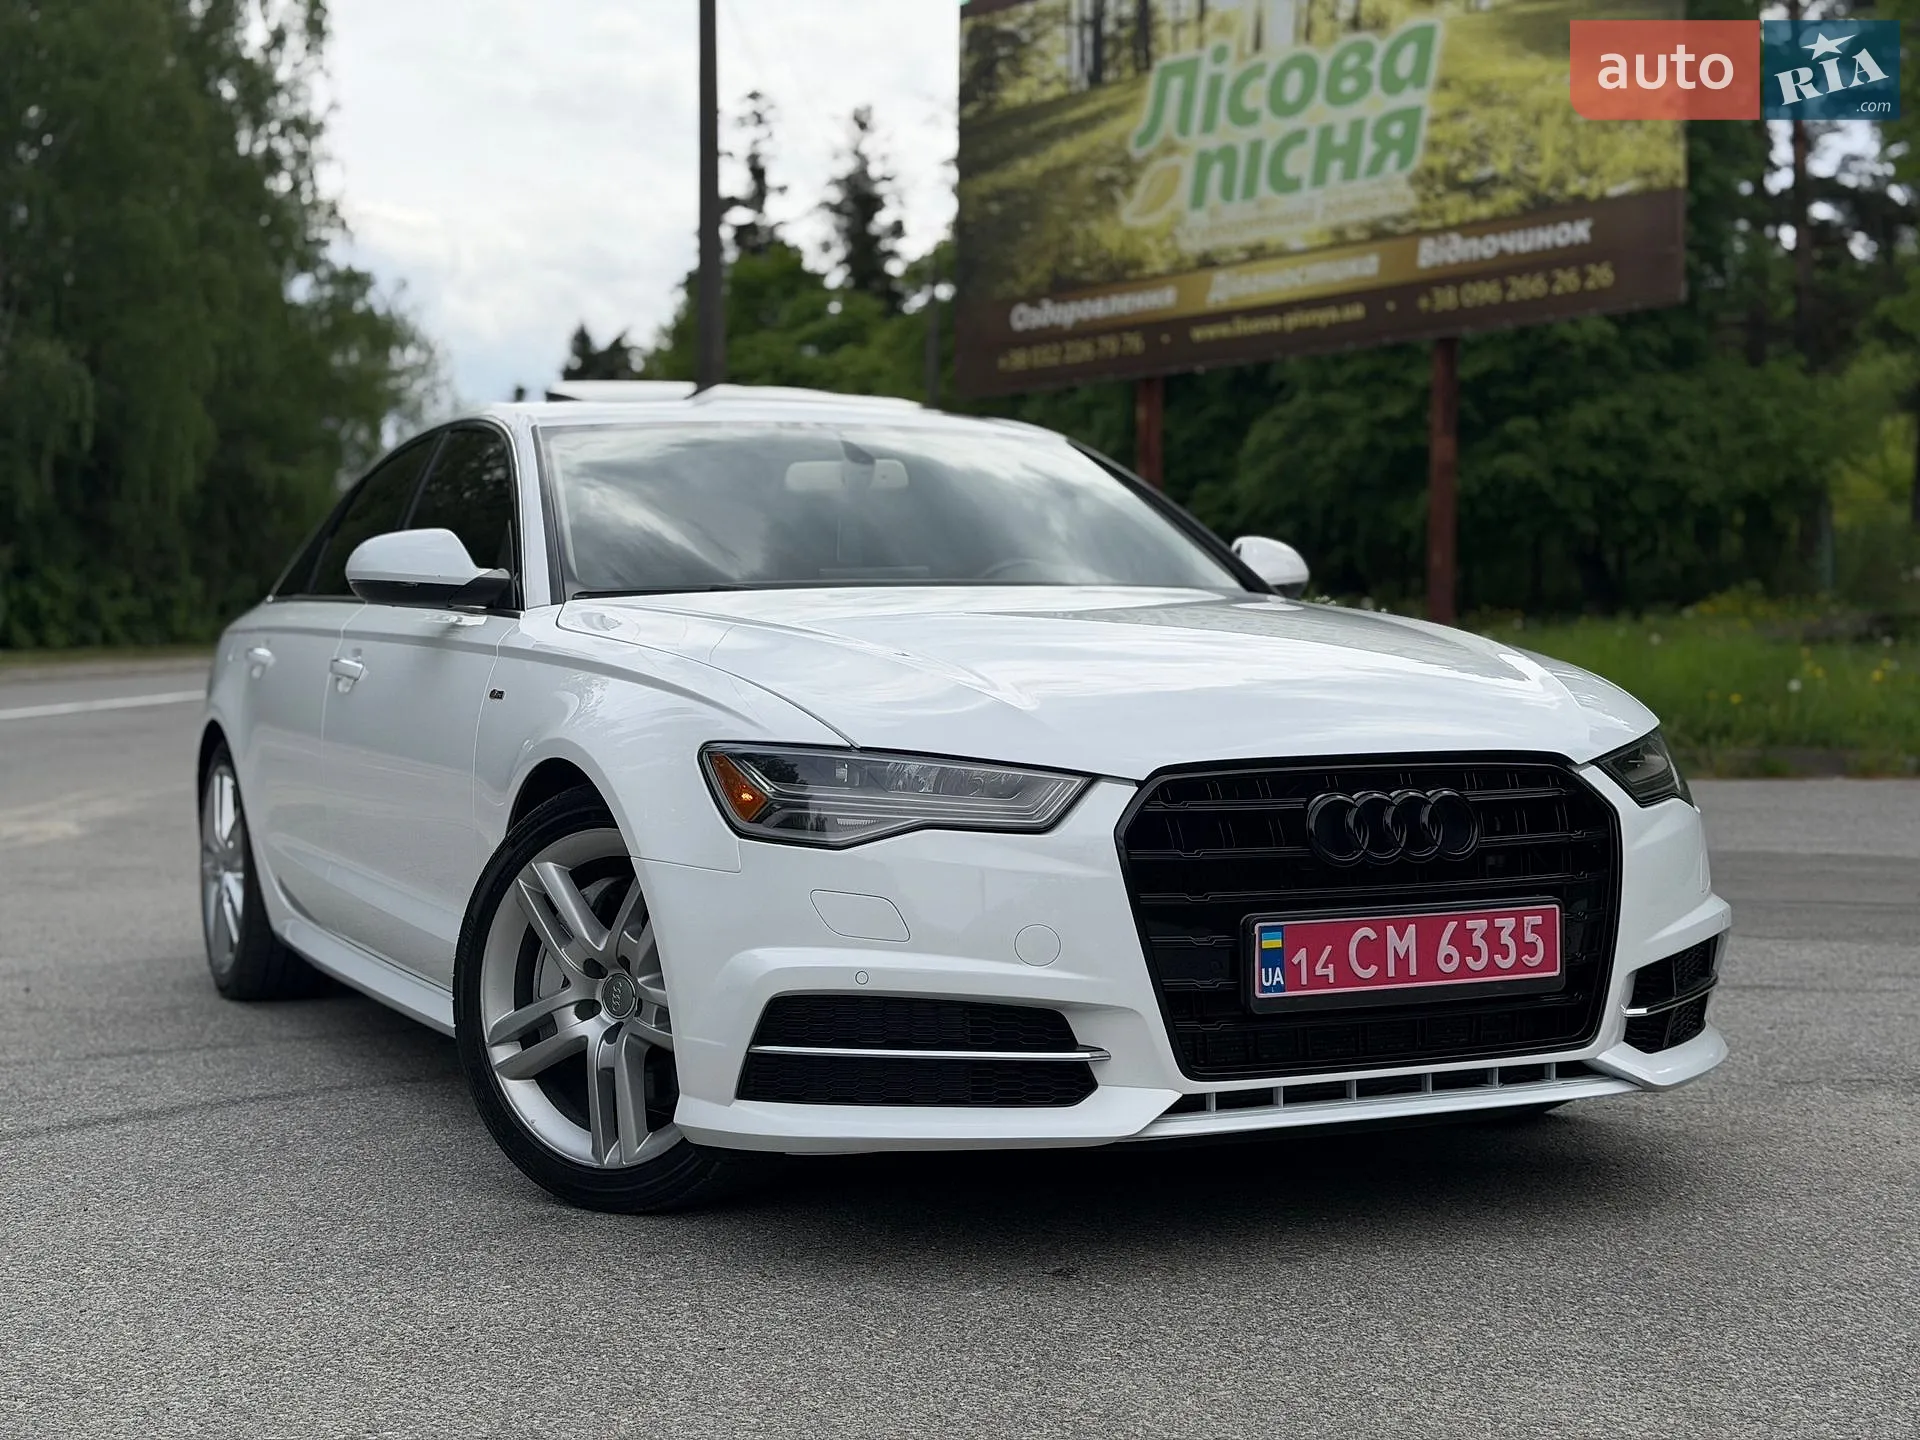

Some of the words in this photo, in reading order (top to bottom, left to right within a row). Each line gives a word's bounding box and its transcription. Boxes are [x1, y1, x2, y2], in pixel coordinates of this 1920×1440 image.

[1134, 22, 1438, 150] Лісова
[1416, 216, 1594, 270] Відпочинок
[1417, 284, 1459, 313] +38
[1551, 266, 1582, 296] 26
[1583, 260, 1616, 290] 26
[1261, 967, 1284, 987] UA
[1291, 945, 1335, 986] 14
[1348, 923, 1418, 979] CM
[1436, 915, 1545, 974] 6335
